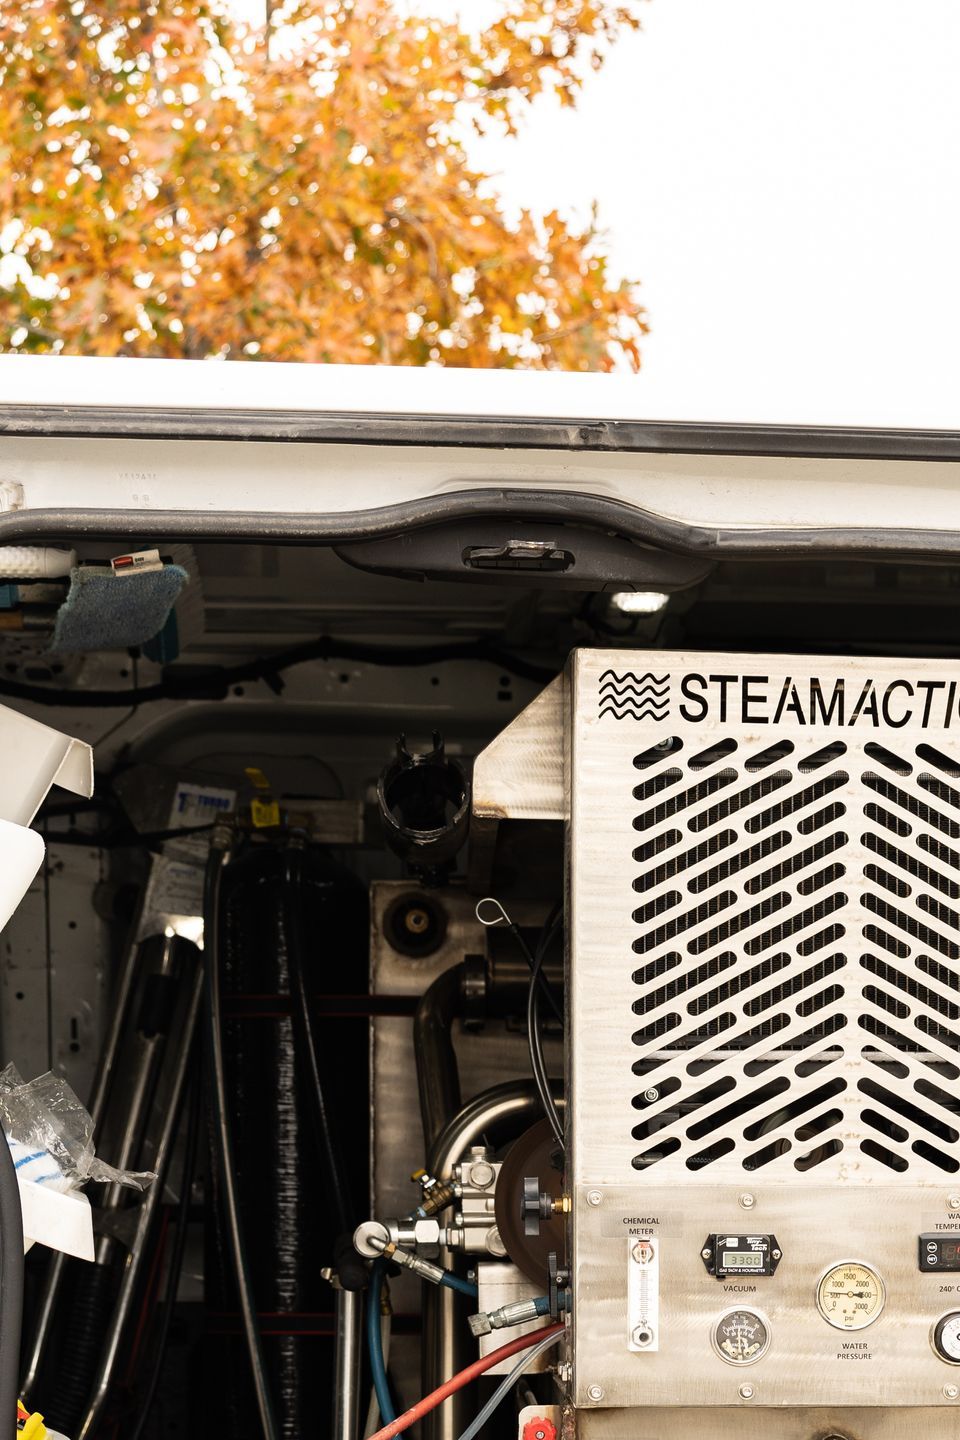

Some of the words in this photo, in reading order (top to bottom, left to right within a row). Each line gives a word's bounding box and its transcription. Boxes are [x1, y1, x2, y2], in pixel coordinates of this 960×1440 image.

[623, 1217, 660, 1225] CHEMICAL
[731, 1256, 760, 1265] 3300
[855, 1280, 870, 1288] 2000
